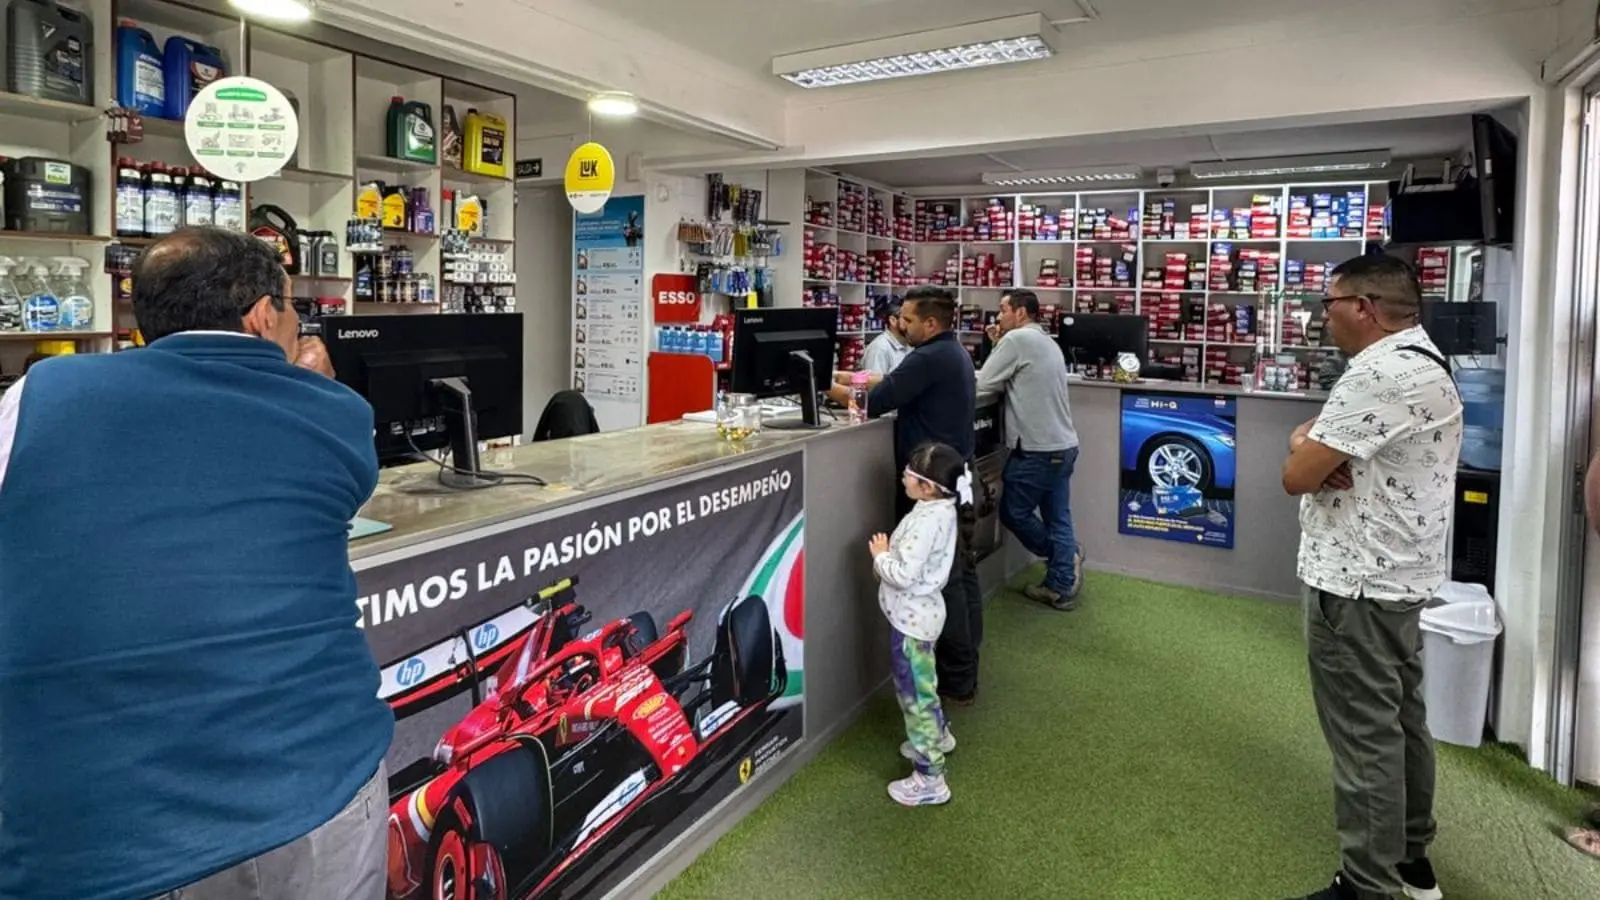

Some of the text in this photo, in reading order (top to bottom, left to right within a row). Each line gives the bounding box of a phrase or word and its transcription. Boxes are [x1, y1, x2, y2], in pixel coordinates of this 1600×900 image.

[580, 160, 598, 177] LUK
[658, 291, 696, 304] ESSO
[337, 328, 379, 340] Lenovo
[477, 555, 517, 592] LA
[523, 521, 623, 577] PASIÓN
[628, 507, 672, 542] POR
[676, 500, 696, 525] EL
[699, 469, 792, 517] DESEMPEÑO
[477, 625, 499, 649] hp
[399, 661, 423, 687] hp
